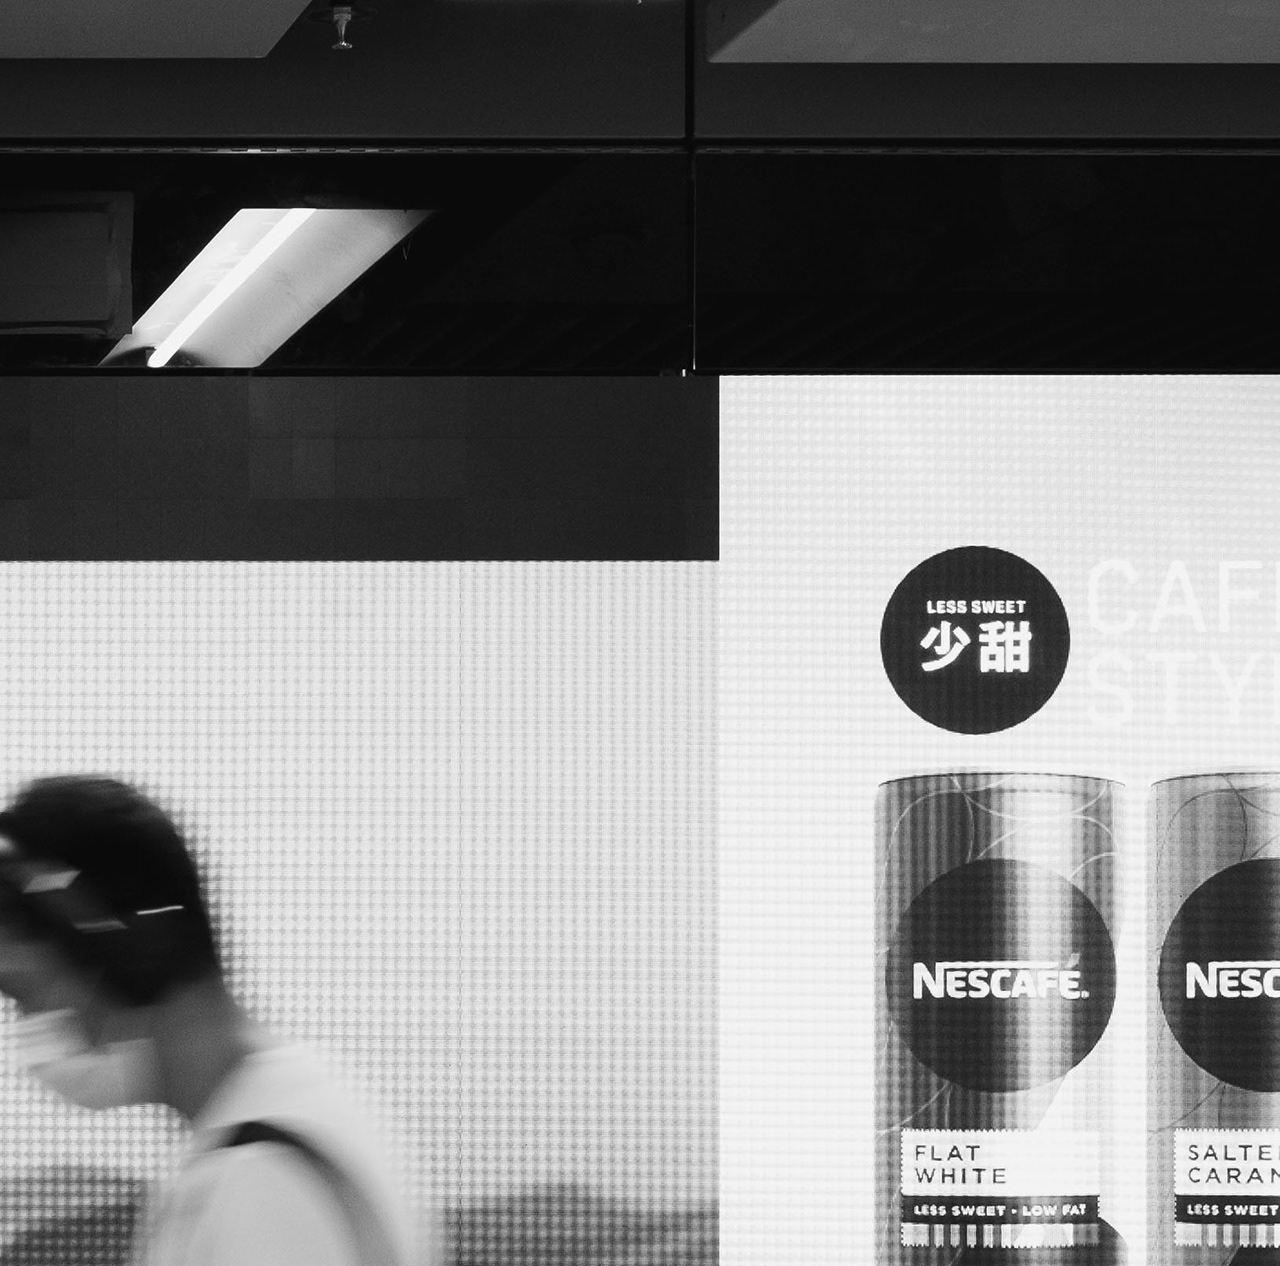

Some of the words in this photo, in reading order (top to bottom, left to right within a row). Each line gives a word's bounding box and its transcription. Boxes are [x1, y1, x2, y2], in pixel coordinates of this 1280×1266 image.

[1087, 557, 1280, 634] CAF
[926, 599, 968, 615] LESS
[971, 599, 1027, 615] SWEET
[920, 620, 1033, 673] 少甜
[1087, 651, 1280, 728] STY
[915, 1144, 981, 1162] FLAT
[1188, 1144, 1280, 1162] SALTE
[914, 1167, 1006, 1185] WHITE
[914, 1203, 947, 1217] LESS
[951, 1204, 1006, 1217] SWEET
[1022, 1203, 1059, 1217] LOW
[1062, 1203, 1087, 1217] FAT
[1187, 1203, 1220, 1216] LESS
[1224, 1204, 1280, 1217] SWEET
